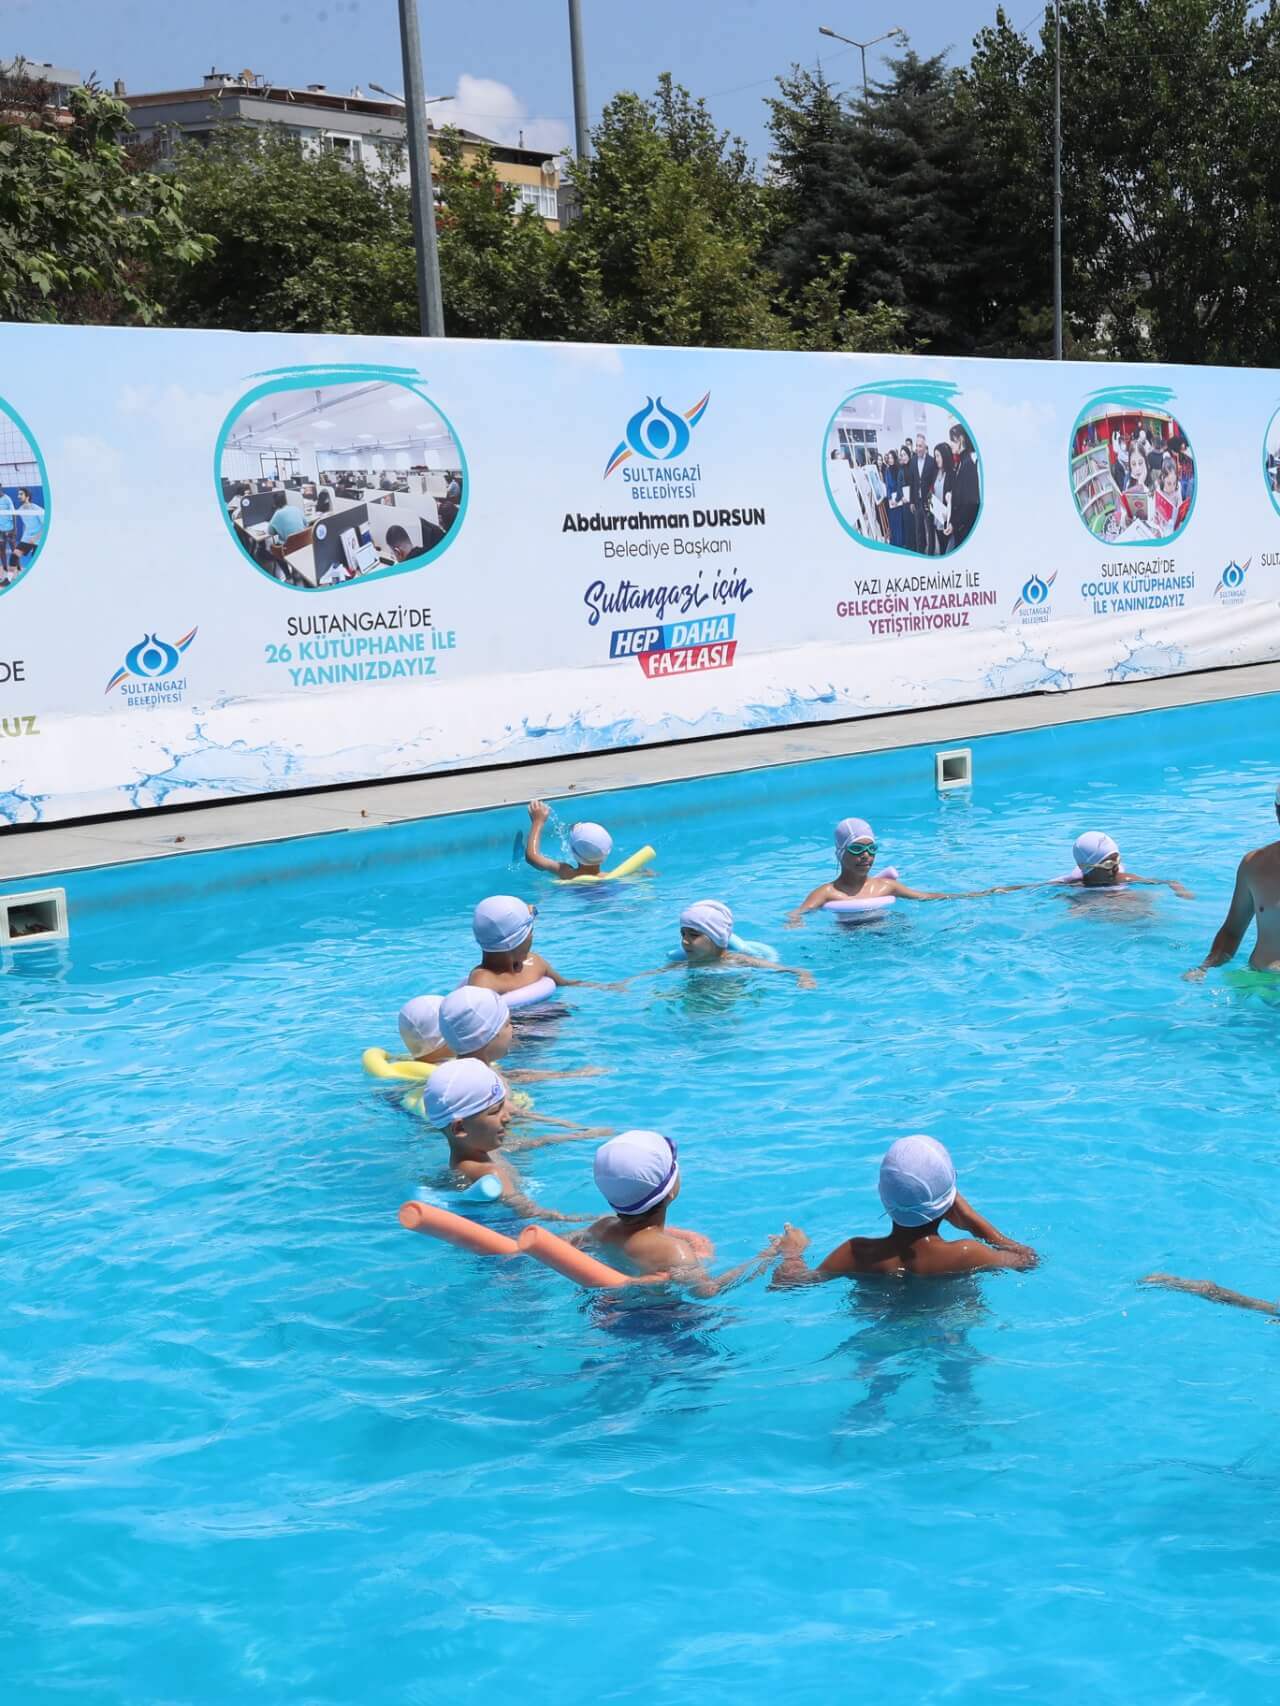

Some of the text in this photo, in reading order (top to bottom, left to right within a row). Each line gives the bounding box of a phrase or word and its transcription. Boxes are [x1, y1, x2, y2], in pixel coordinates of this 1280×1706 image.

[622, 464, 702, 482] SULTANGAZİ
[631, 483, 696, 500] BELEDİYESİ
[562, 508, 766, 533] Abdurrahman DURSUN
[604, 536, 732, 559] Belediye Başkanı
[854, 569, 980, 596] YAZI AKADEMİMİZ İLE
[1081, 571, 1195, 602] ÇOCUK KÜTÜPHANESİ
[584, 567, 753, 626] Sultangazi için
[836, 590, 997, 618] GELECEĞİN YAZARLARINI
[1093, 593, 1185, 615] İLE YANINIZDAYIZ
[614, 617, 730, 656] HEP DAHA
[868, 611, 970, 637] YETİŞTİRİYORUZ
[264, 626, 456, 664] 26 KÜTÜPHANE İLE
[287, 656, 437, 687] YANINIZDAYIZ
[648, 643, 729, 677] FAZLASI
[121, 678, 187, 695] SULTANGAZİ
[127, 692, 182, 707] BELEDİYESİ
[0, 715, 41, 738] UZ
